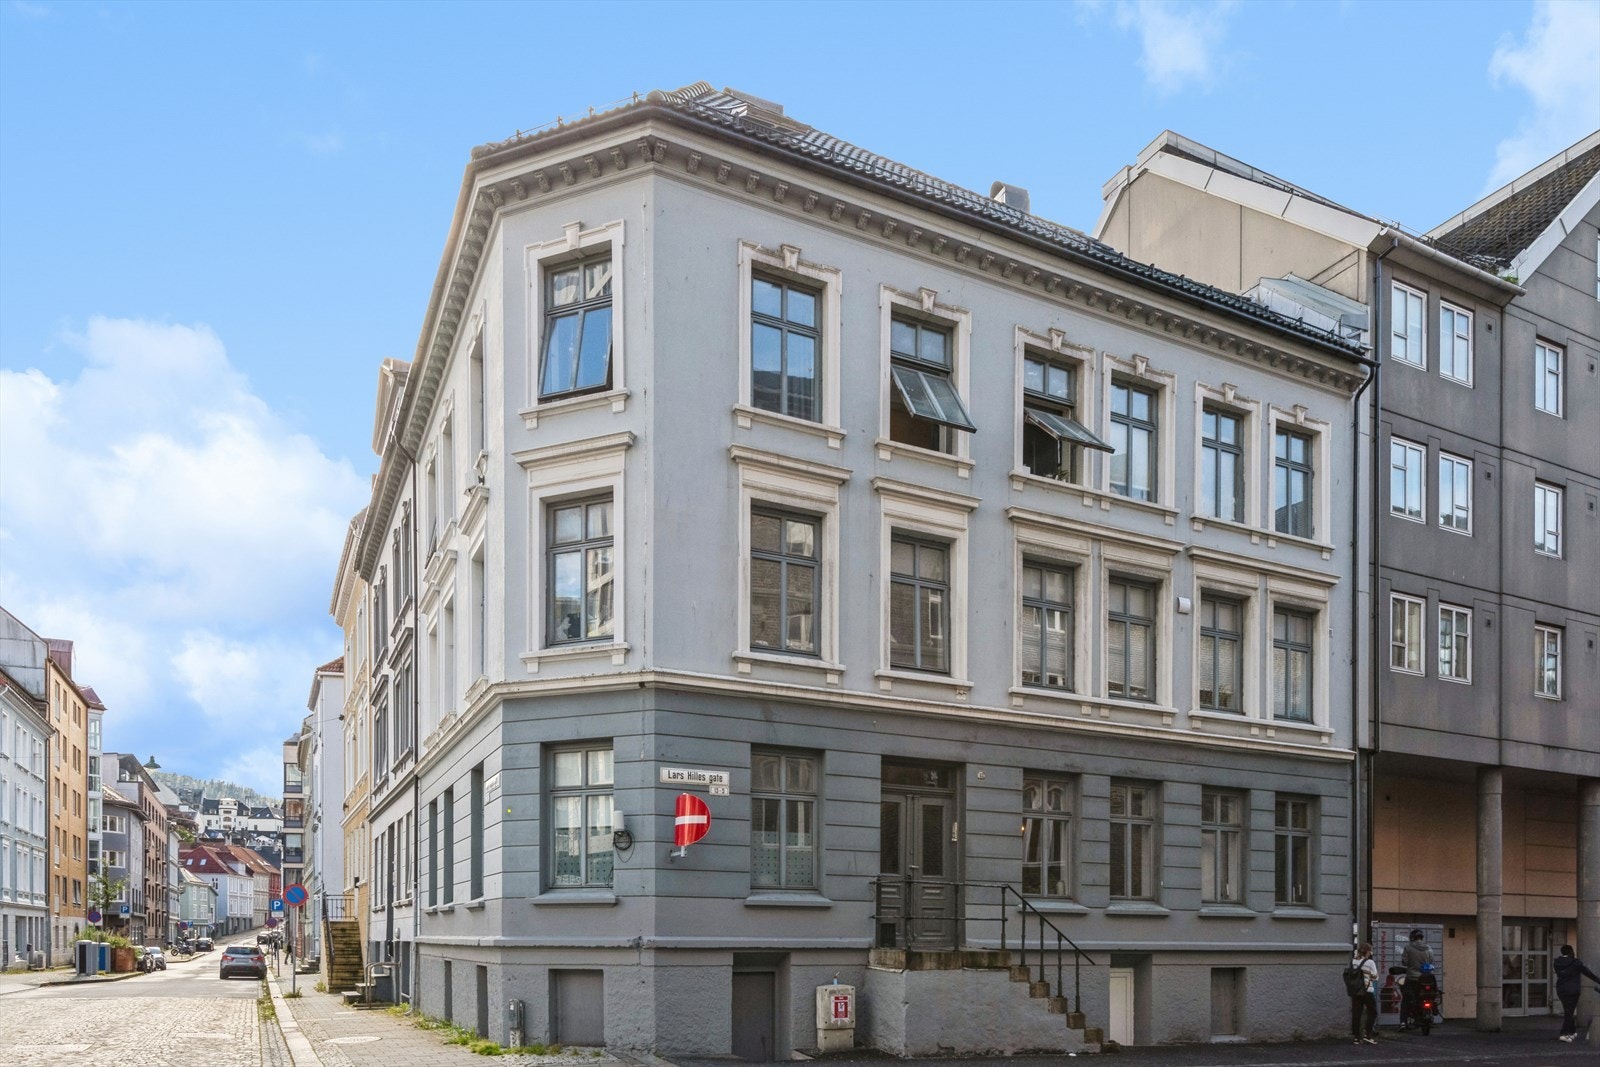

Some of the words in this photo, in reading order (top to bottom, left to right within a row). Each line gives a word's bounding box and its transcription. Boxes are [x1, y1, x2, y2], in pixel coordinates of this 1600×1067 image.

[668, 769, 684, 780] Lars
[687, 771, 706, 781] Hilles
[709, 773, 723, 784] gate
